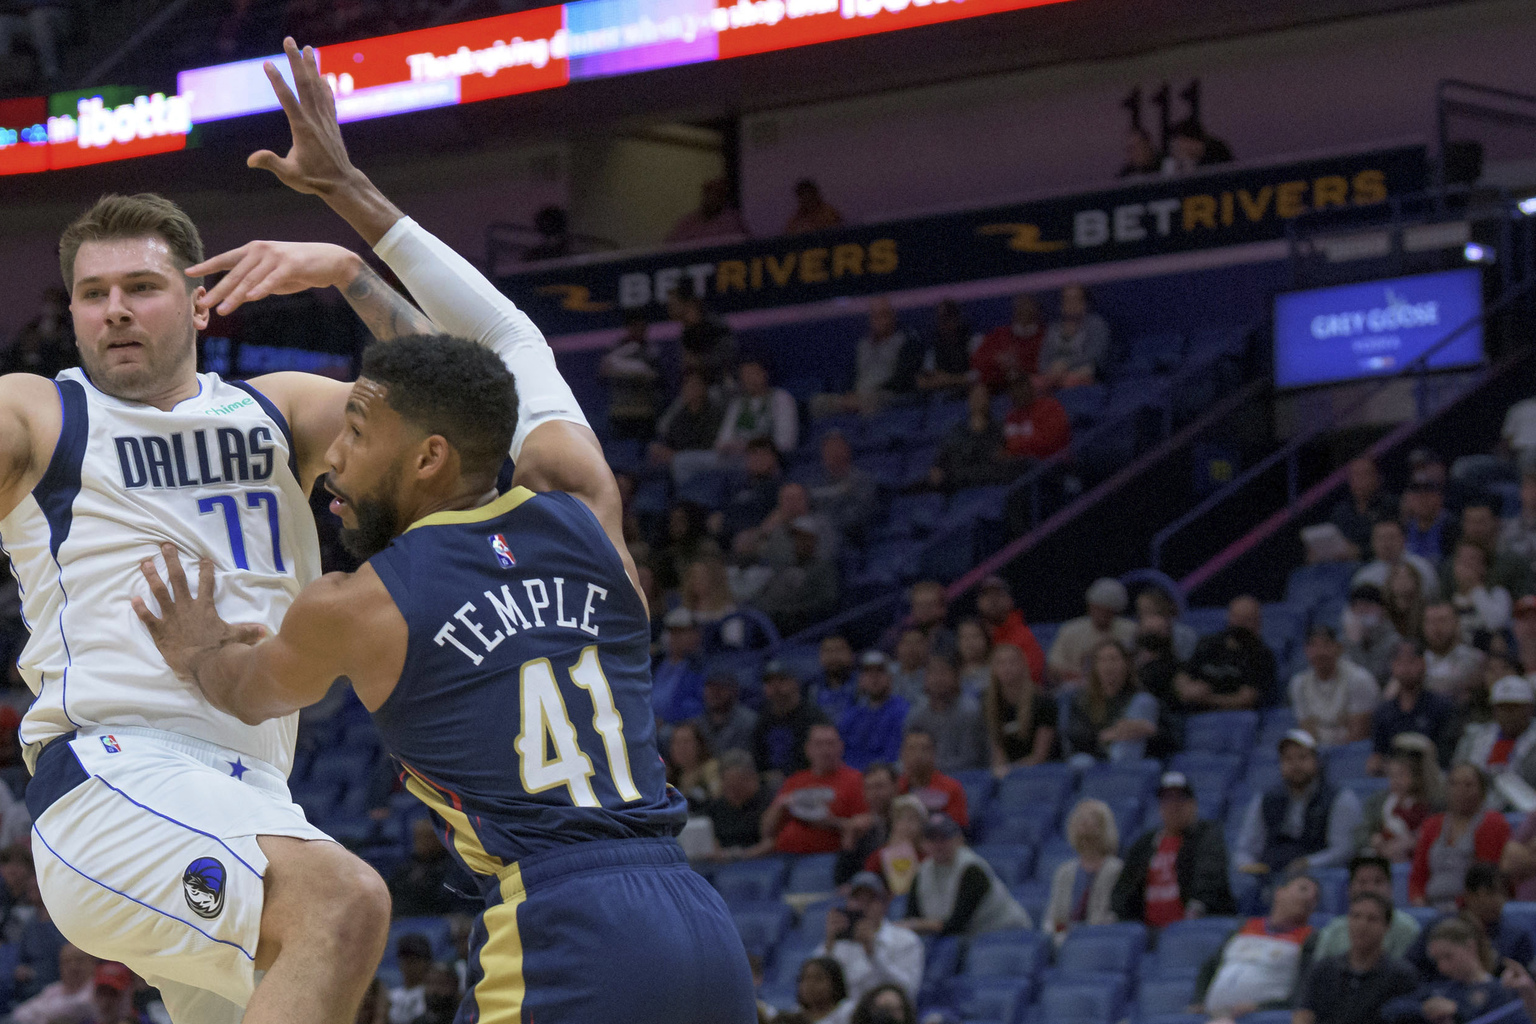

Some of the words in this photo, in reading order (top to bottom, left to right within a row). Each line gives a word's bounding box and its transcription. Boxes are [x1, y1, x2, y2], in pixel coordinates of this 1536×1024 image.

[77, 93, 194, 148] ibotta
[1072, 169, 1388, 247] BETRIVERS
[617, 238, 900, 309] BETRIVERS
[112, 426, 274, 491] DALLAS
[197, 491, 287, 575] 77
[433, 577, 608, 667] TEMPLE
[514, 644, 643, 808] 41
